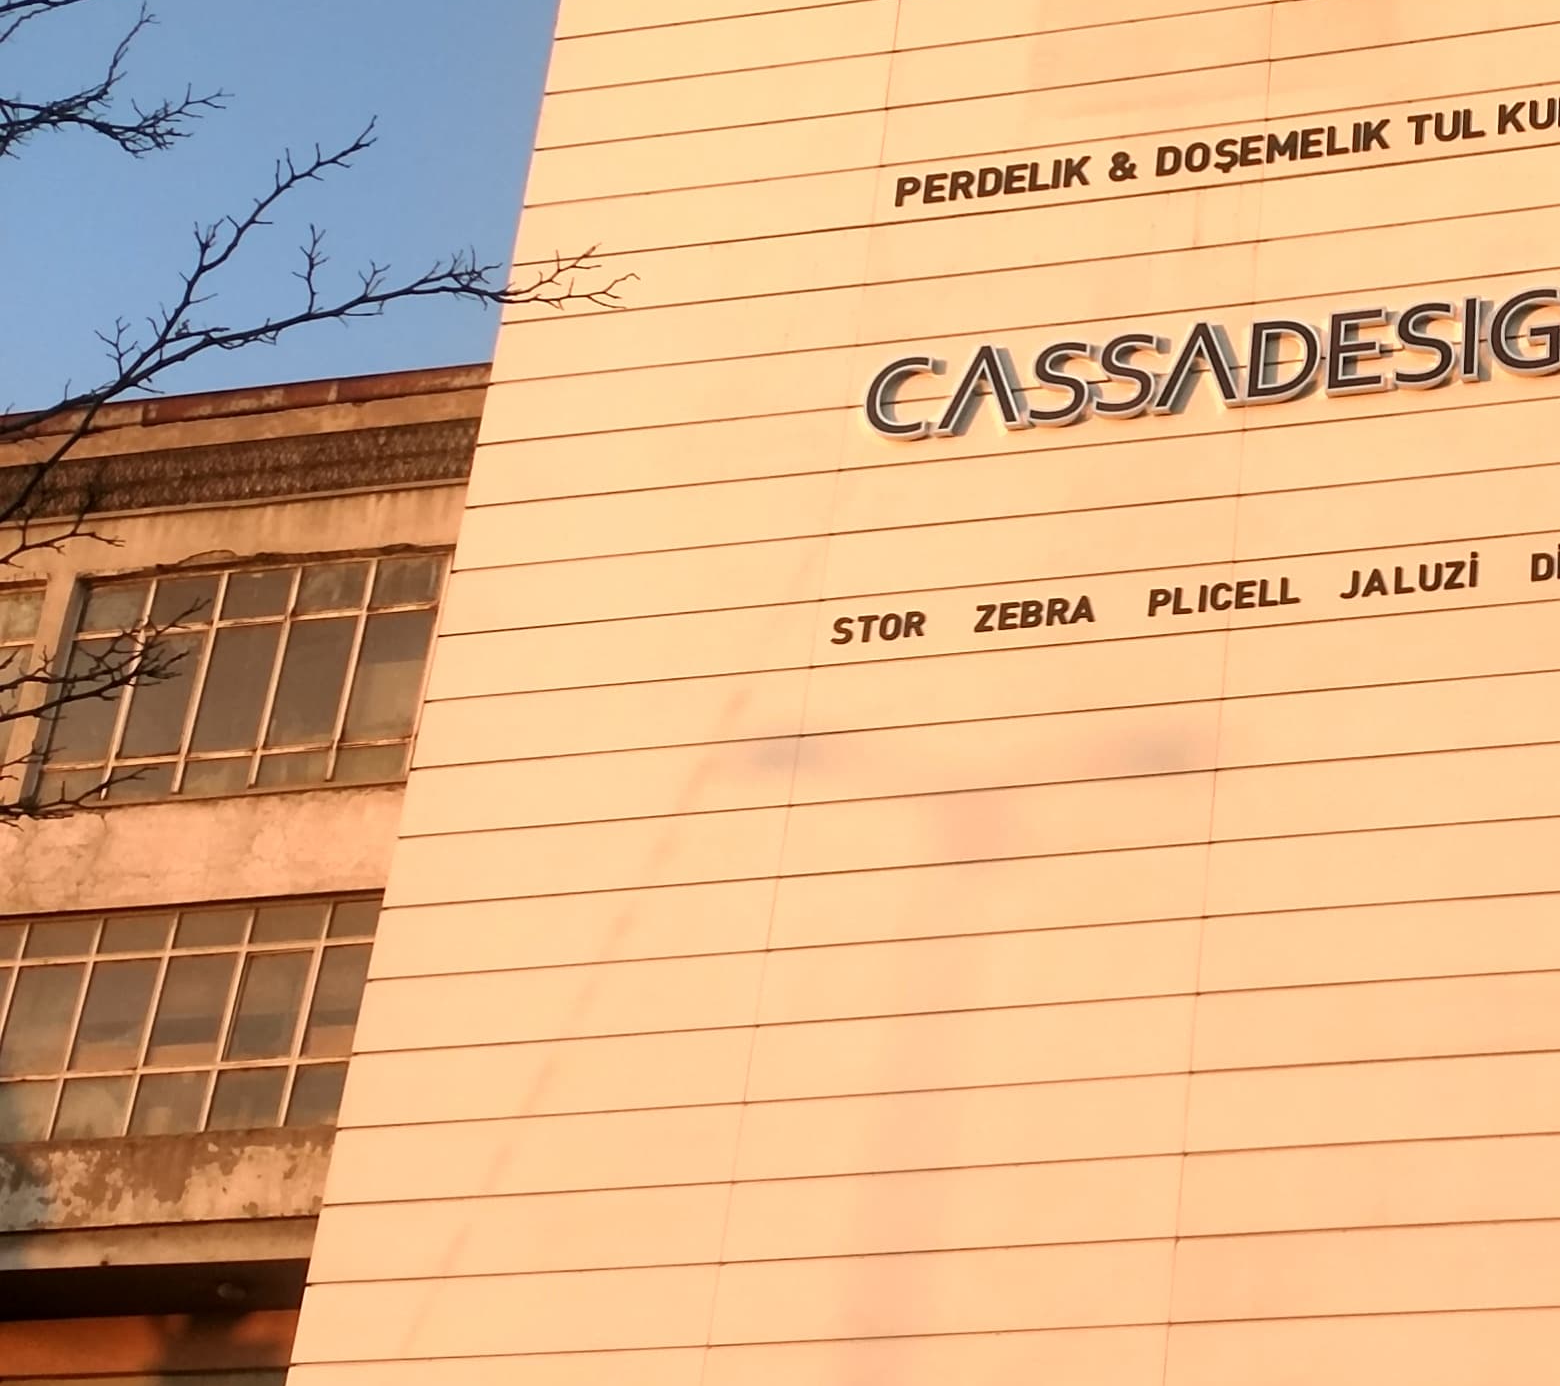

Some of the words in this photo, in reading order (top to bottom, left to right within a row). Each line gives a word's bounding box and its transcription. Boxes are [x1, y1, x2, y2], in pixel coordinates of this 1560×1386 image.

[894, 155, 1091, 207] PERDELIK
[1108, 151, 1138, 182] &
[1155, 119, 1391, 175] DOŞEMELIK
[1407, 108, 1486, 146] TUL
[830, 611, 927, 645] STOR
[973, 595, 1096, 633] ZEBRA
[1148, 577, 1301, 617] PLICELL
[1339, 551, 1480, 600] JALUZİ
